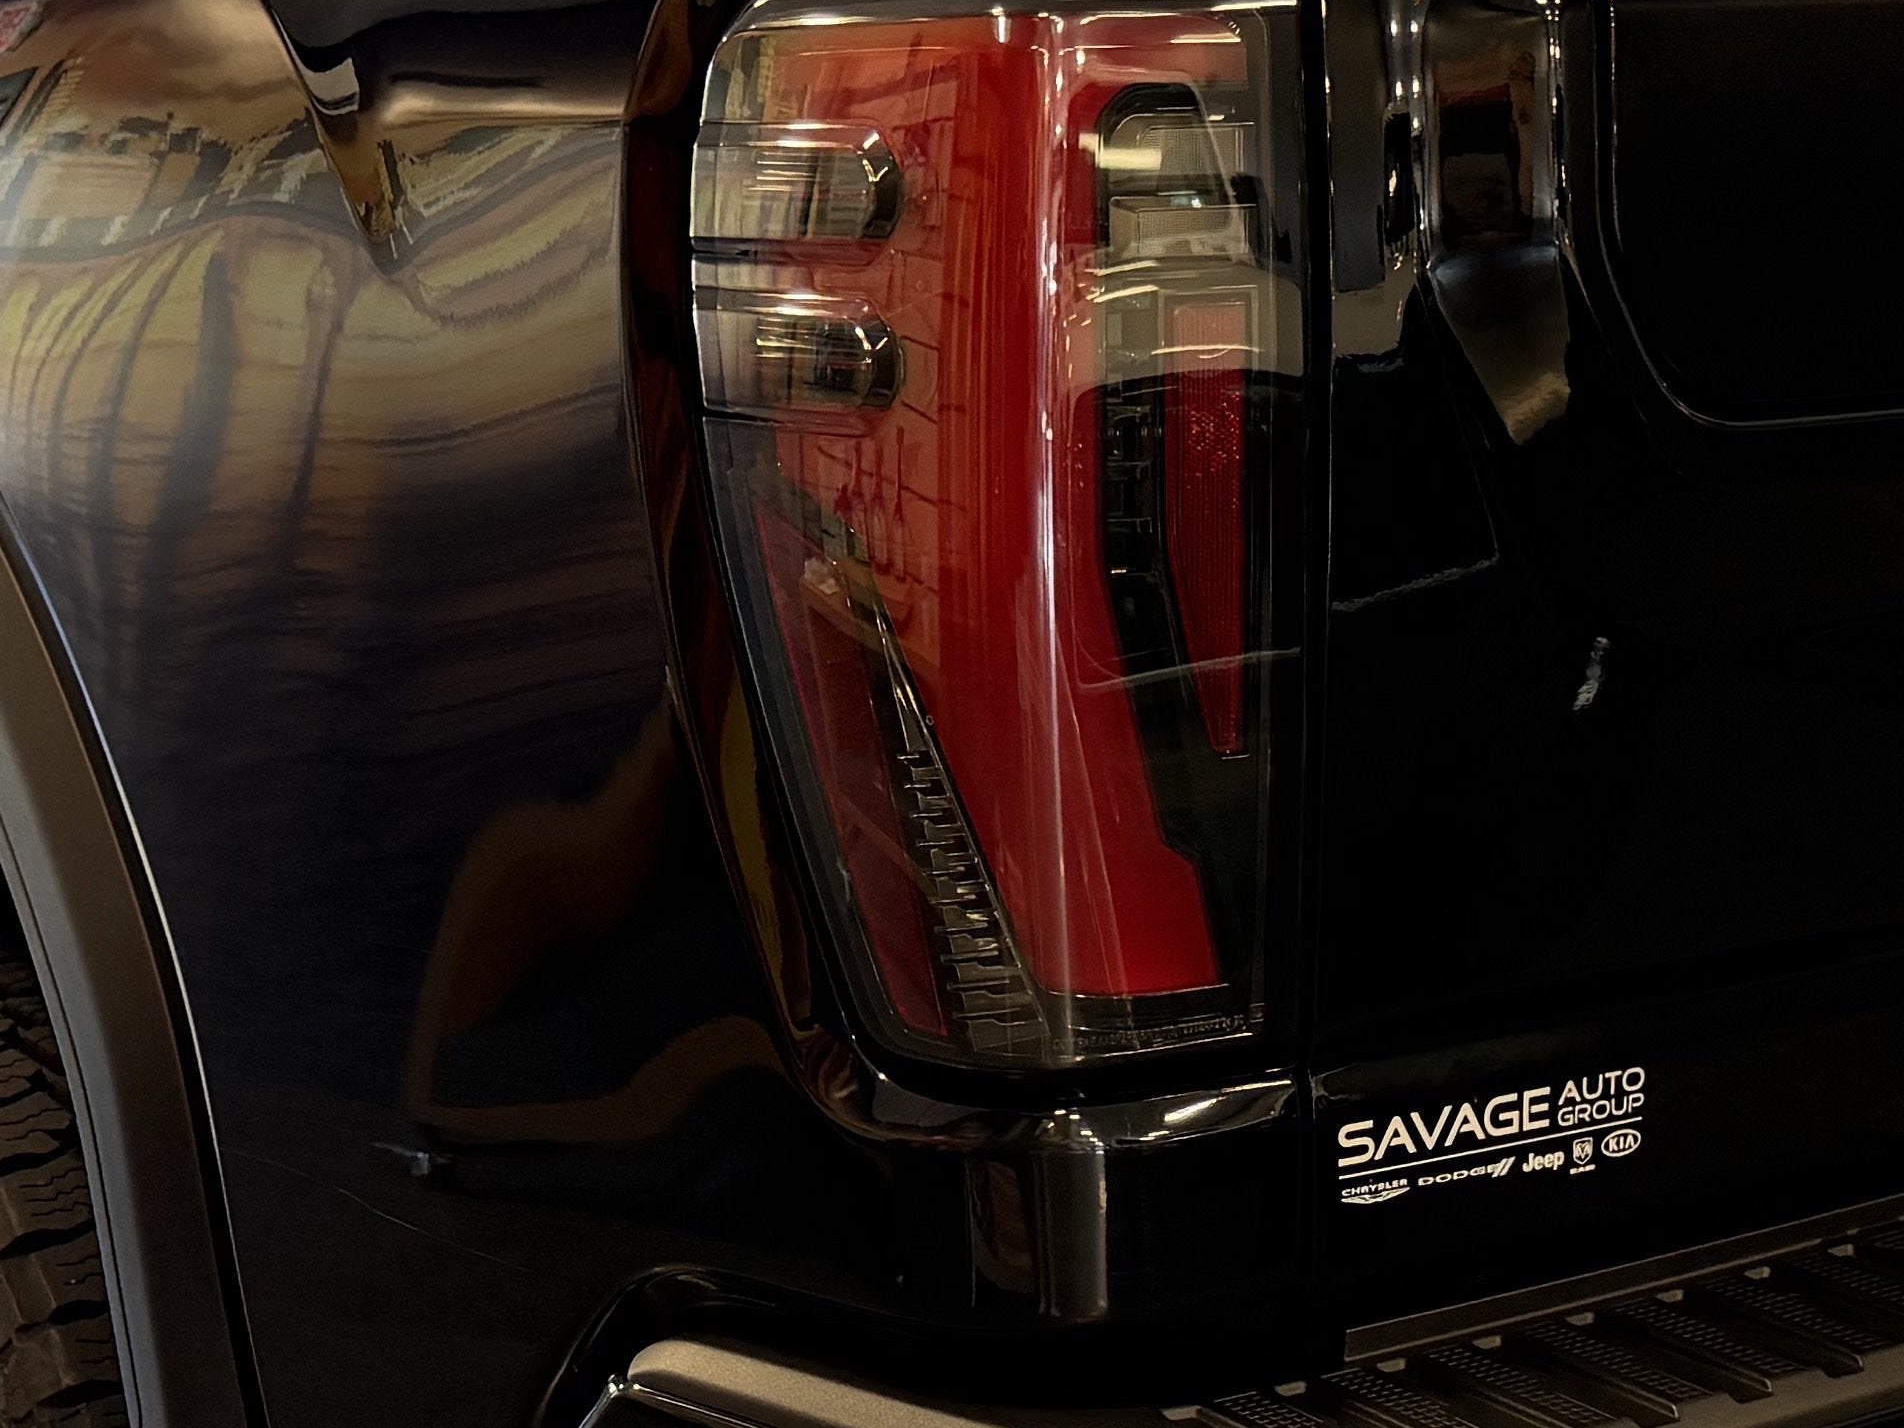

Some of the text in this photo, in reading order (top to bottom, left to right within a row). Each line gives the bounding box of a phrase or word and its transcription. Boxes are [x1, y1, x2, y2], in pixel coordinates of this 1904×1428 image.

[1337, 1067, 1645, 1167] SAVAGE AUTO
[1557, 1093, 1644, 1126] GROUP
[1341, 1178, 1408, 1196] CHRYSLER
[1418, 1163, 1502, 1186] DODGE
[1522, 1151, 1565, 1172] Jeep
[1609, 1134, 1635, 1152] KIA
